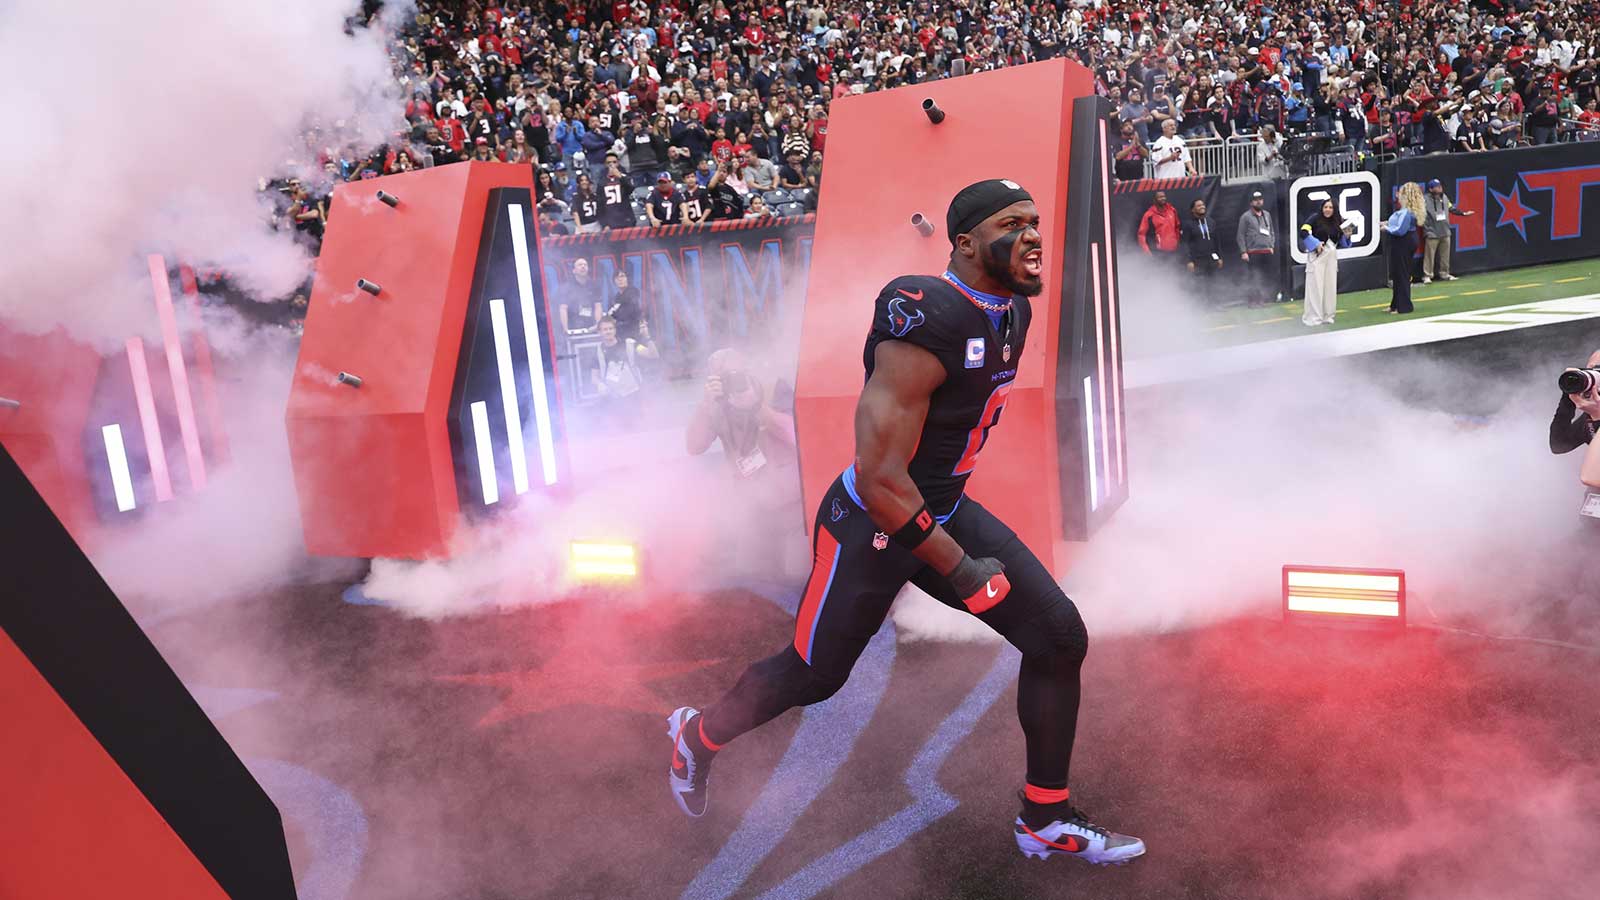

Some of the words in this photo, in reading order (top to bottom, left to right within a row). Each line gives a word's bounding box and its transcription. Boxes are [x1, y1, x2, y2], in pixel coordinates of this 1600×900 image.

[751, 31, 759, 41] 7
[479, 119, 490, 133] 3
[599, 113, 611, 128] 51
[1468, 132, 1475, 144] 7
[604, 184, 621, 204] 51
[583, 201, 595, 217] 51
[661, 202, 671, 220] 7
[687, 199, 700, 218] 51
[967, 340, 984, 361] C
